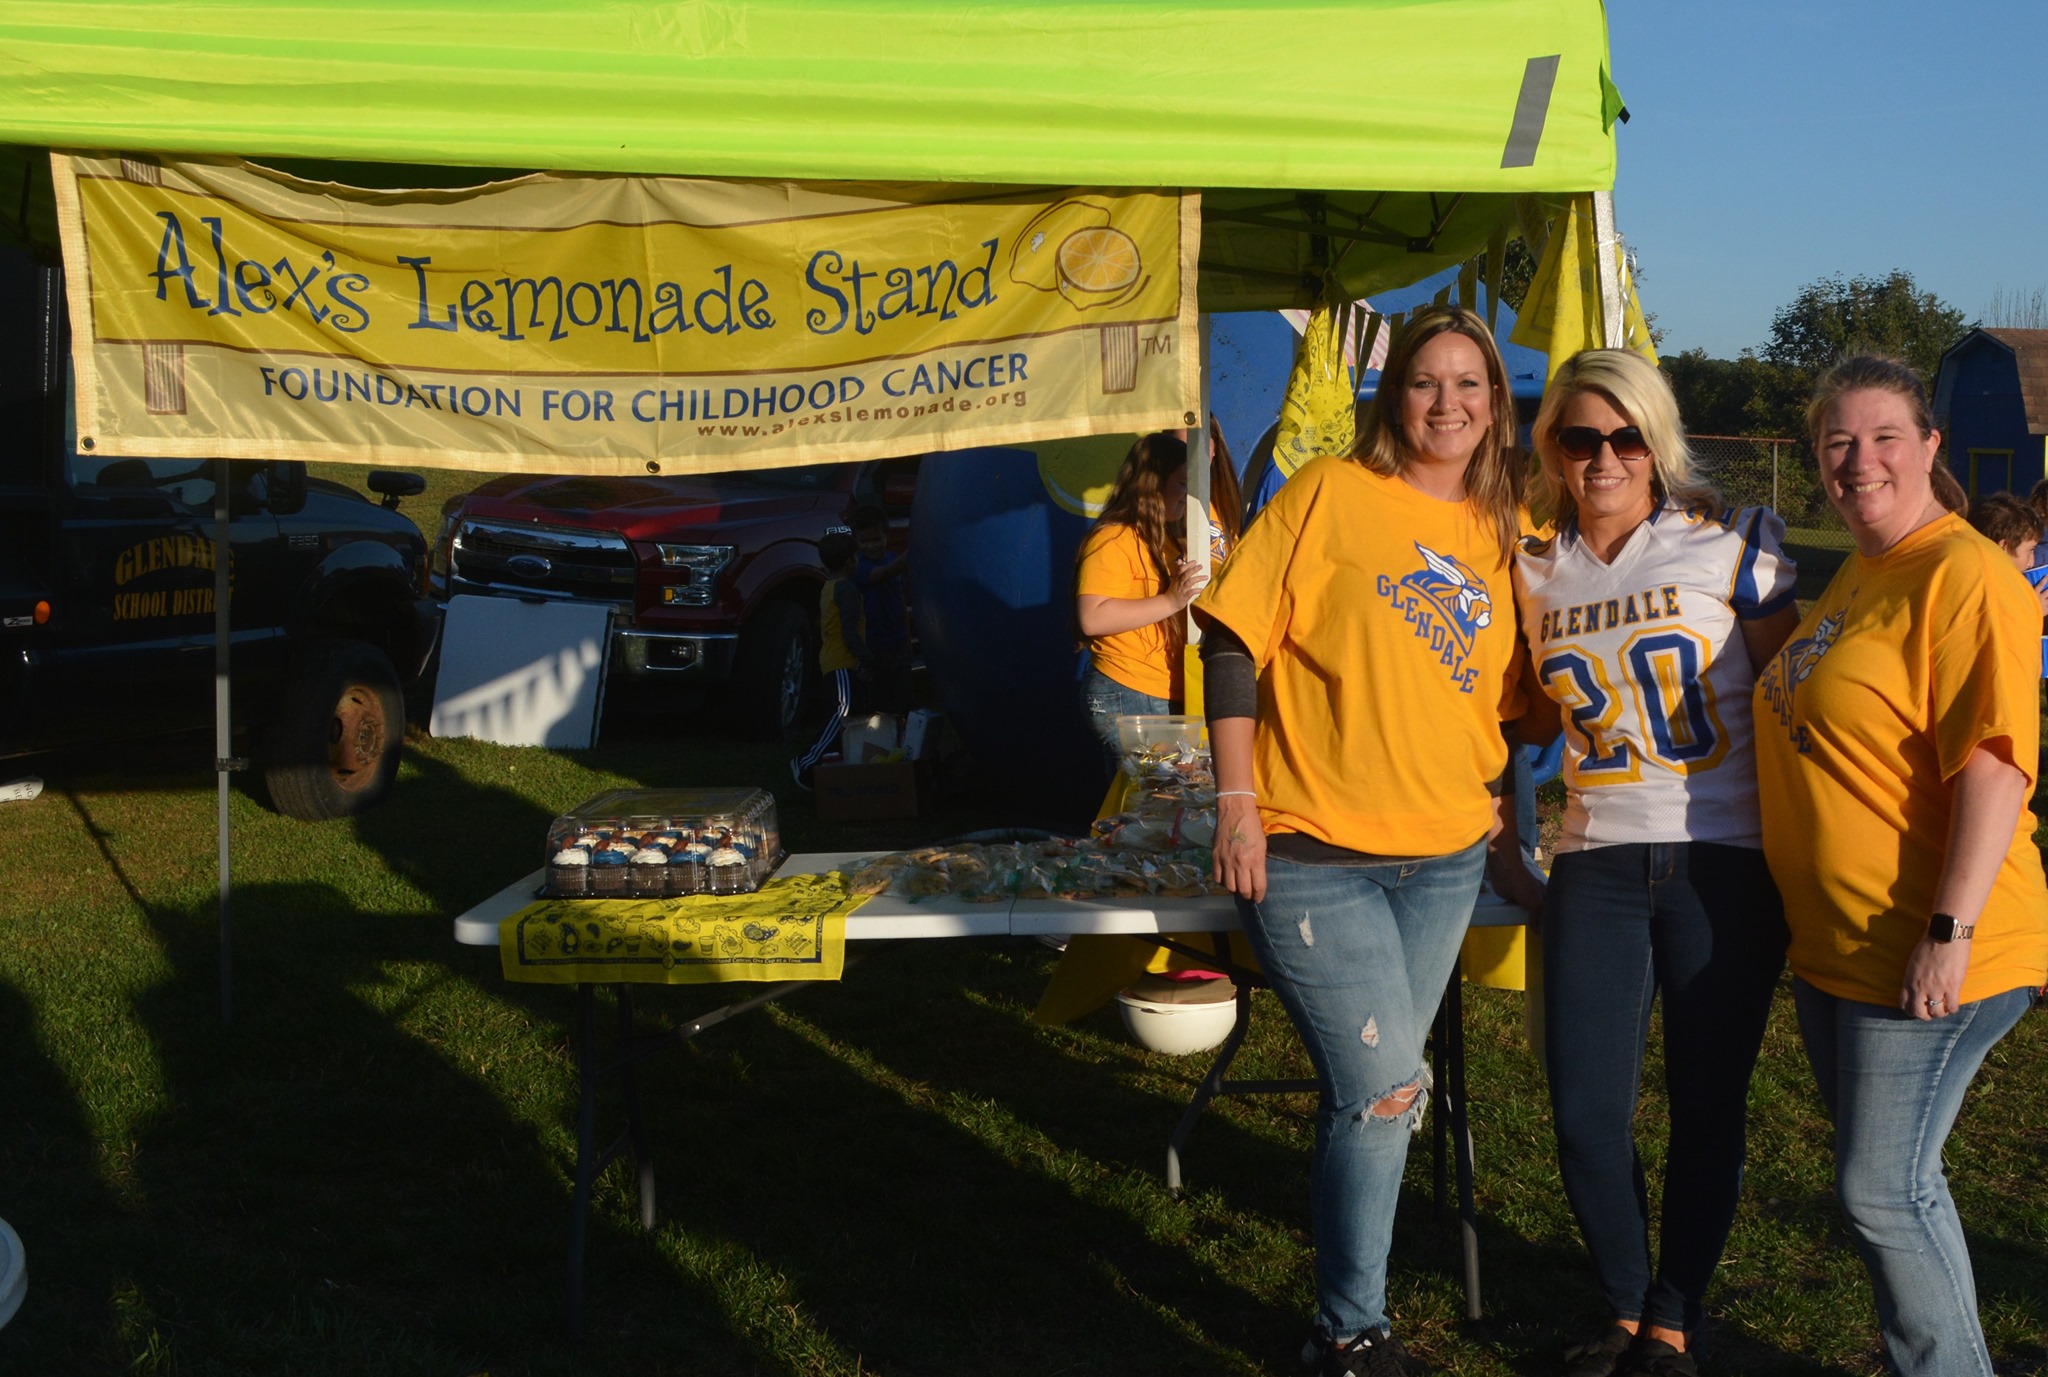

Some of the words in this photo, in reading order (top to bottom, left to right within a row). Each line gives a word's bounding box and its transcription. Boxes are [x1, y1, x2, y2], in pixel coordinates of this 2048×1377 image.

[148, 211, 370, 333] Alex's
[397, 255, 776, 344] Lemonade
[804, 237, 999, 336] Stand
[1142, 335, 1172, 356] TM
[260, 366, 522, 418] FOUNDATION
[542, 389, 614, 422] FOR
[631, 376, 865, 423] CHILDHOOD
[882, 352, 1028, 397] CANCER
[697, 388, 1027, 437] www.alexslemonade.org
[113, 590, 168, 622] SCHOOL
[1376, 574, 1480, 694] GLENDALE
[1540, 584, 1683, 643] GLENDALE
[1538, 623, 1732, 788] 20
